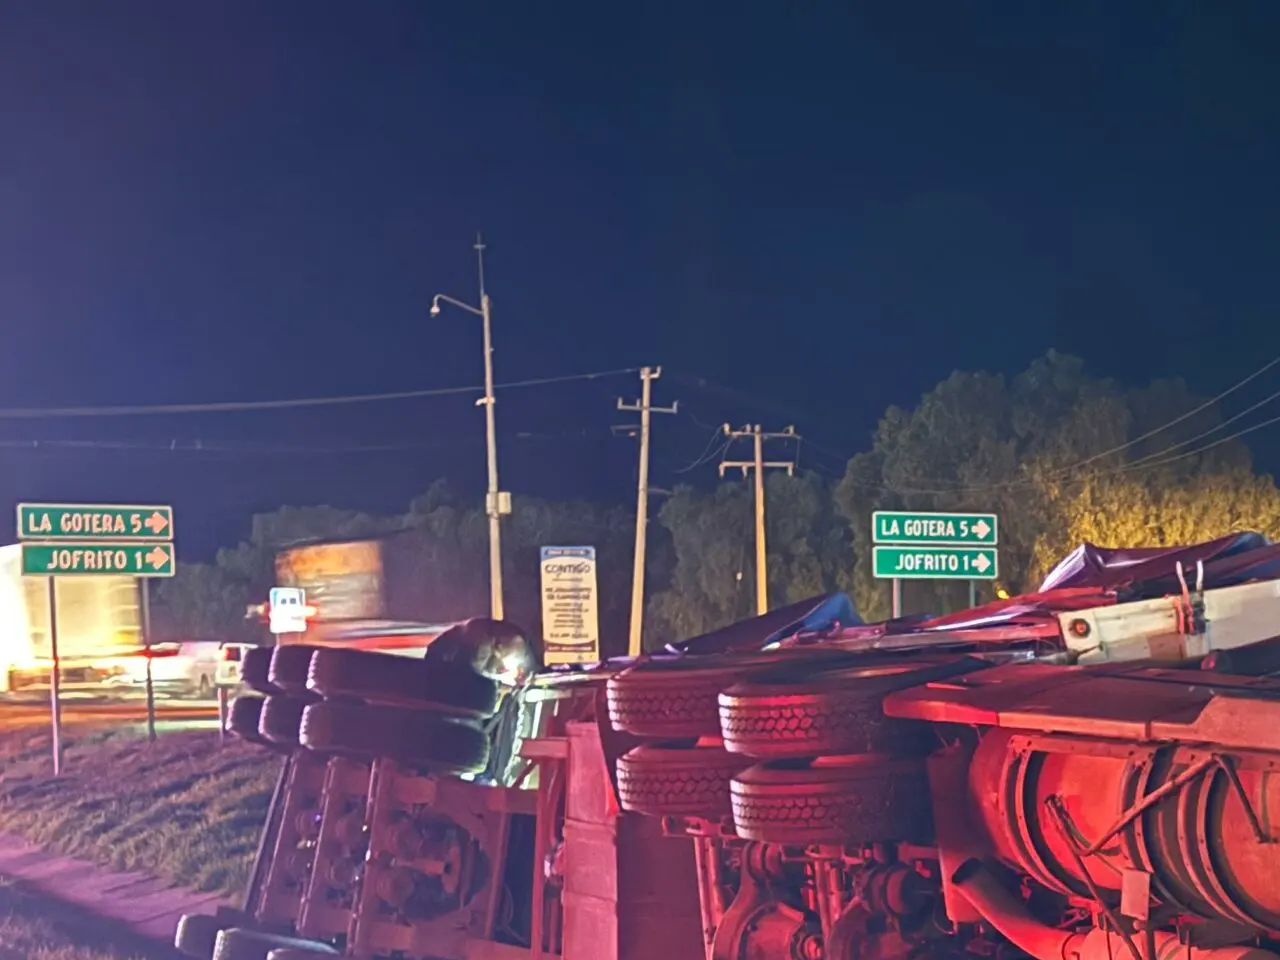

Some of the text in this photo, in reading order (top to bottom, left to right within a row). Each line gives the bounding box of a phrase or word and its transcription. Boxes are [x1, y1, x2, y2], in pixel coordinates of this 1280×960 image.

[28, 512, 142, 534] LA GOTERA 5
[881, 519, 969, 538] LA GOTERA 5
[47, 549, 143, 570] JOFRITO 1
[895, 553, 969, 572] JOFRITO 1
